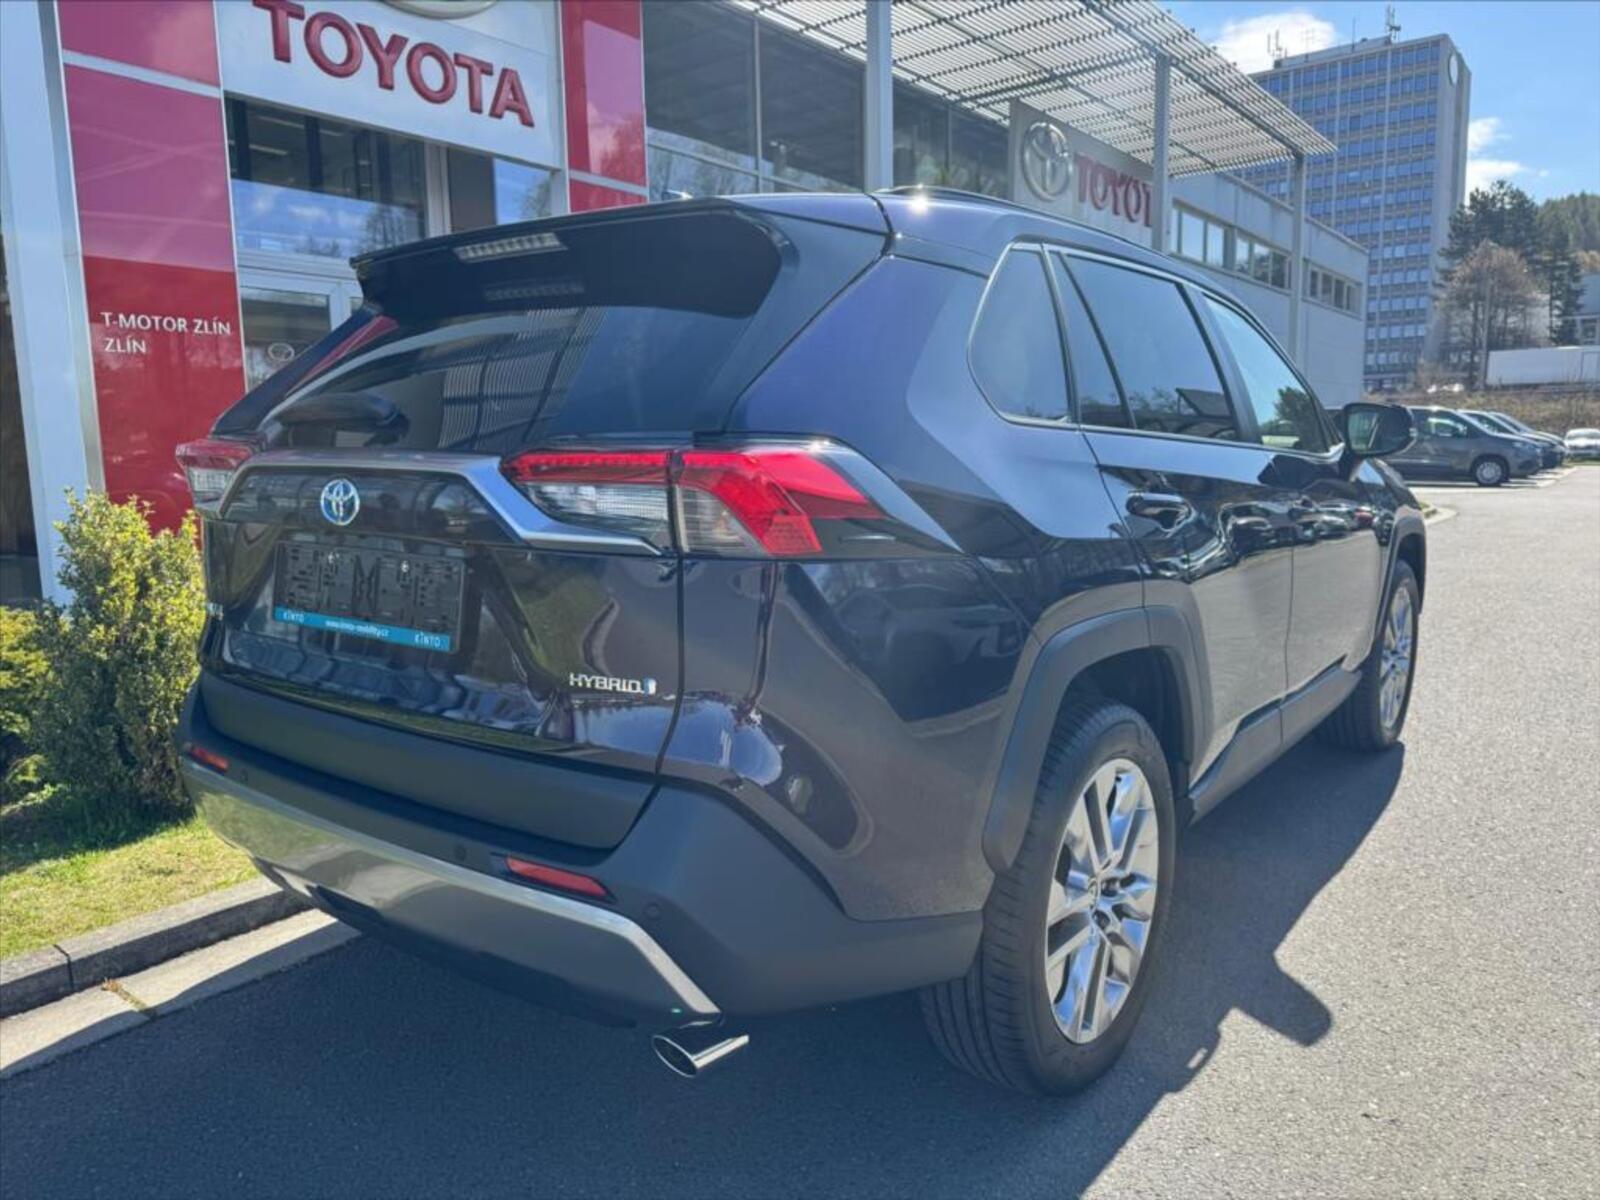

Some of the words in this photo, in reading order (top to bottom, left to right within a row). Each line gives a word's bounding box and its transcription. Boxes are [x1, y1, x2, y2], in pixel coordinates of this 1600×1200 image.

[253, 0, 535, 128] TOYOTA
[1074, 152, 1153, 228] TOYOT
[100, 311, 188, 333] T-MOTOR
[193, 316, 231, 335] ZLÍN
[104, 335, 146, 354] ZLÍN
[414, 631, 441, 648] KINTO
[569, 672, 642, 693] HYBRID
